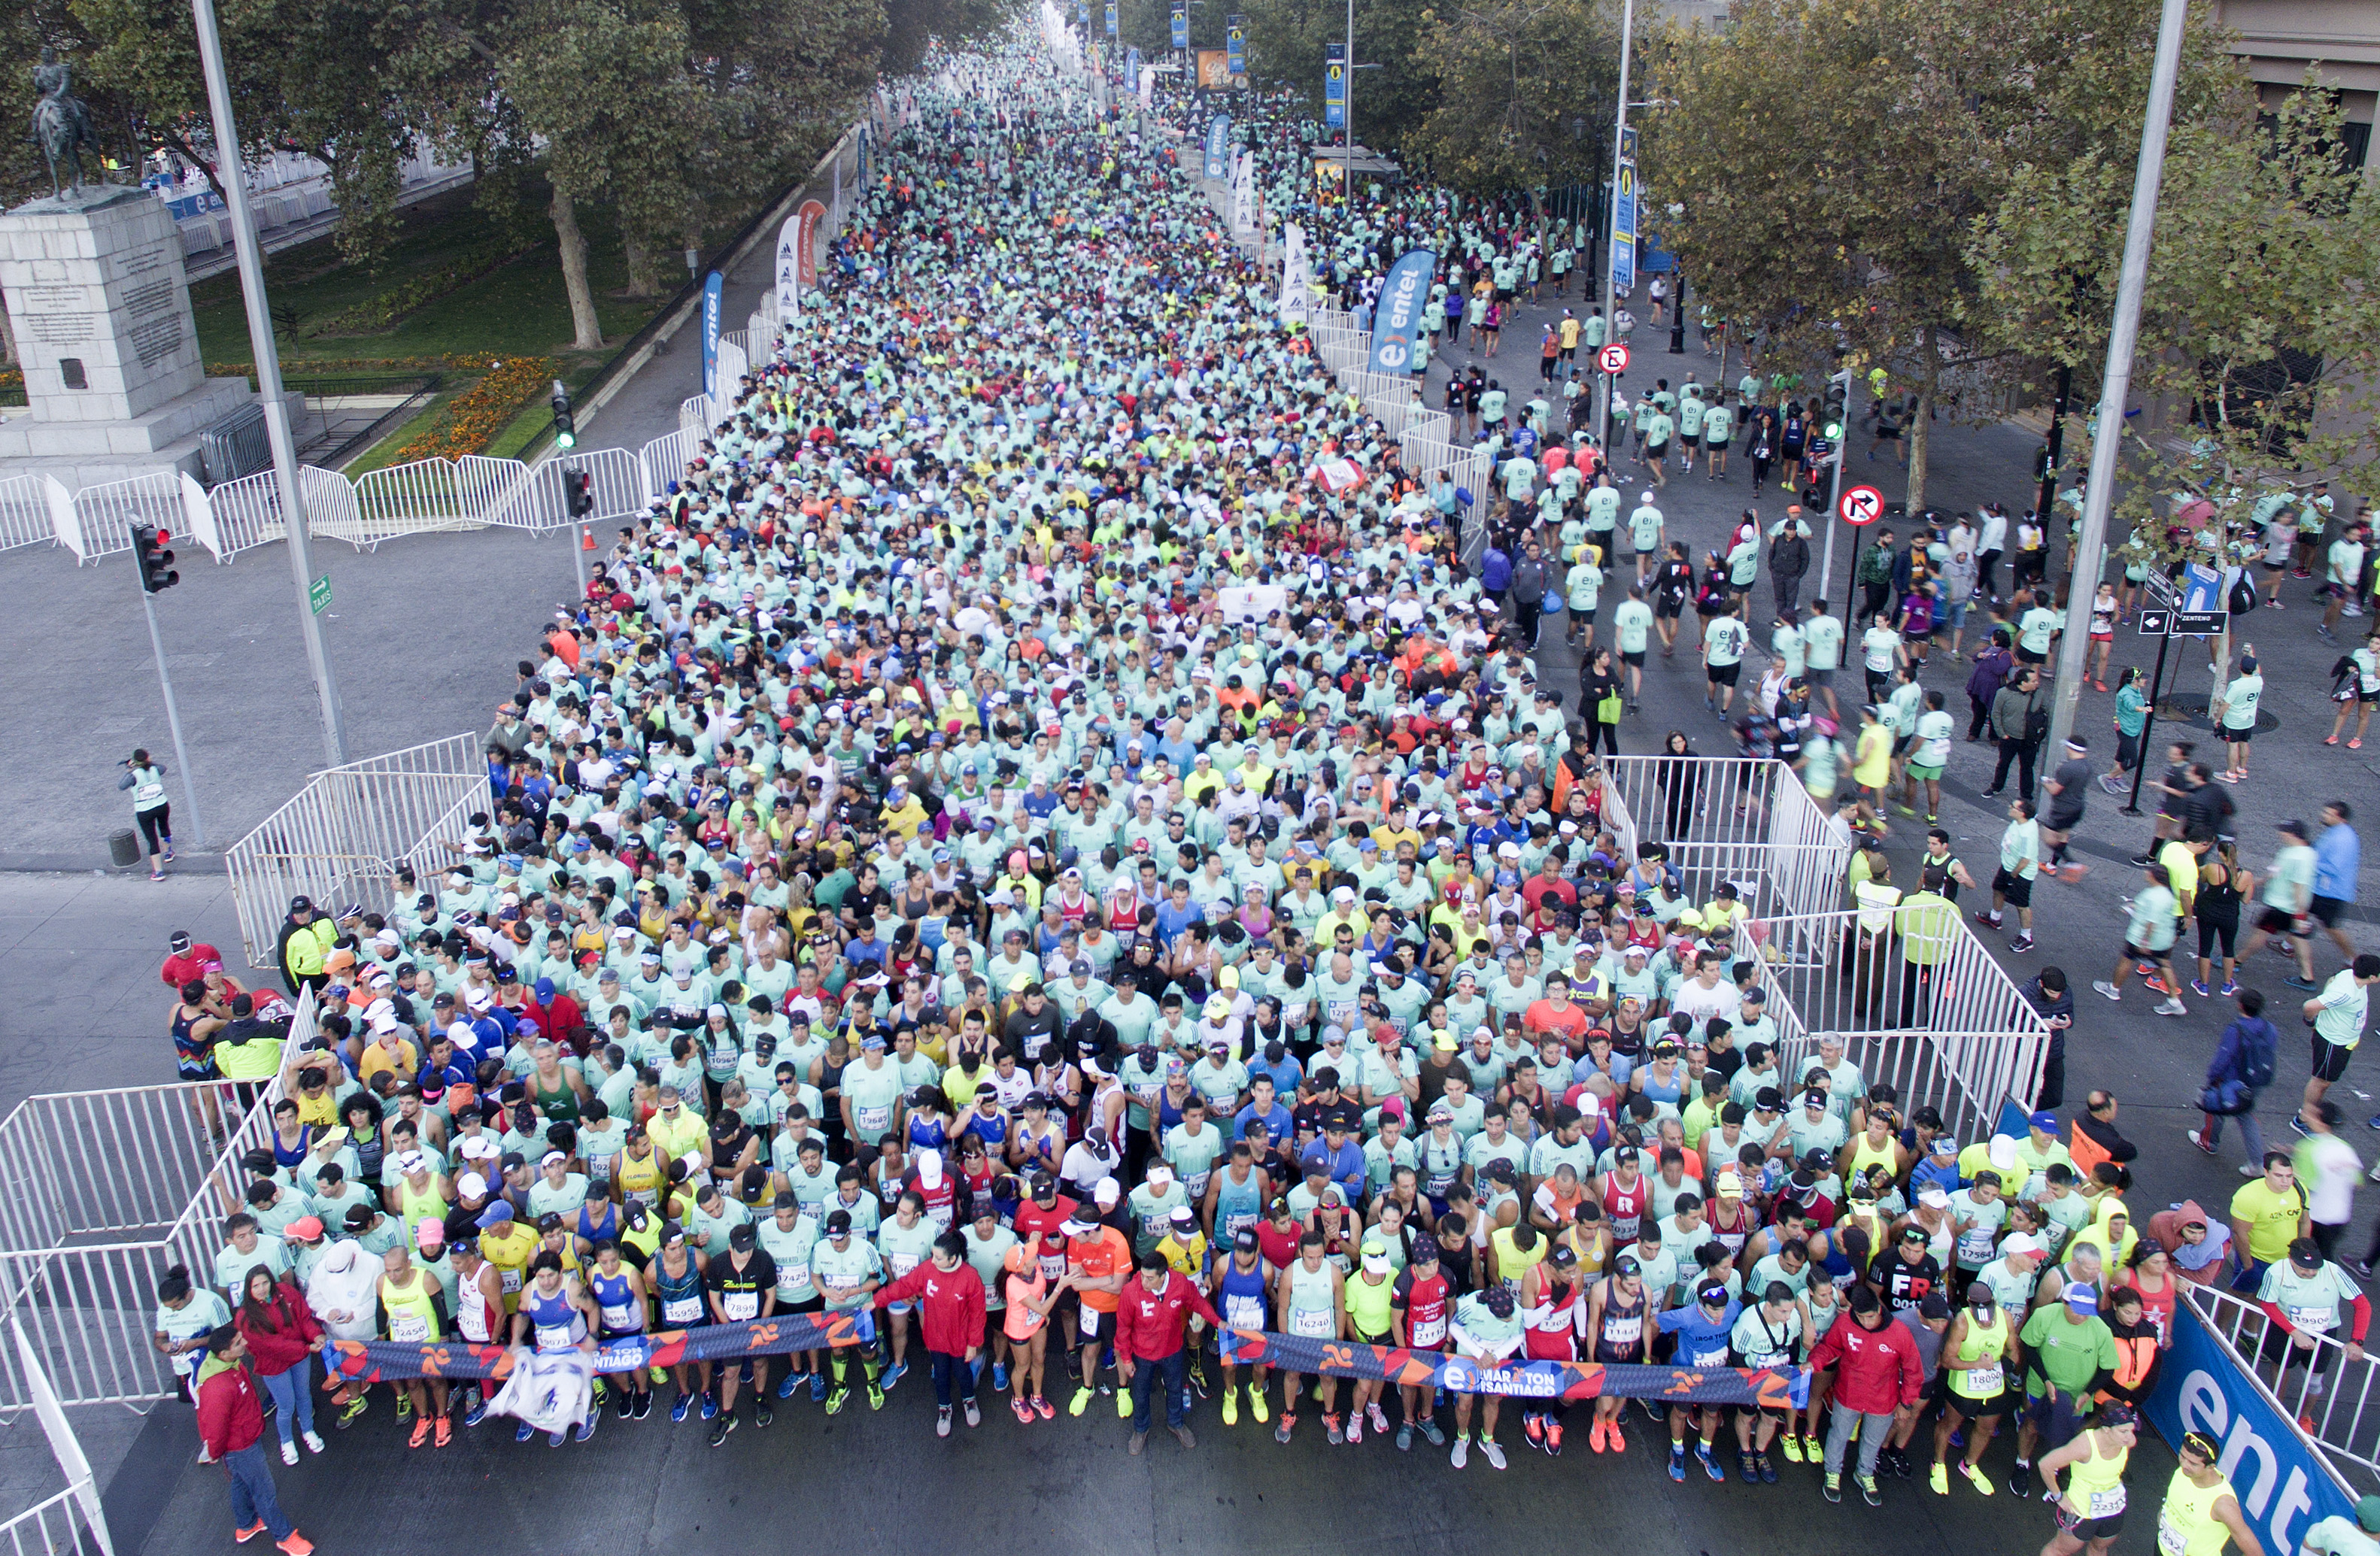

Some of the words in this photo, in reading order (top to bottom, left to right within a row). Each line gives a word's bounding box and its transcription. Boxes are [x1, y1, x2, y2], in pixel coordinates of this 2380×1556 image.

[1213, 124, 1223, 155] entel
[1391, 269, 1419, 329] entel
[709, 291, 717, 352] entel
[312, 590, 331, 611] TAXIS
[1960, 1248, 1992, 1259] 17564
[1892, 1273, 1930, 1298] FR
[669, 1307, 700, 1318] 15954
[395, 1325, 426, 1337] 12450
[1299, 1319, 1329, 1328] 16240
[1486, 1382, 1556, 1397] SANTIAGO
